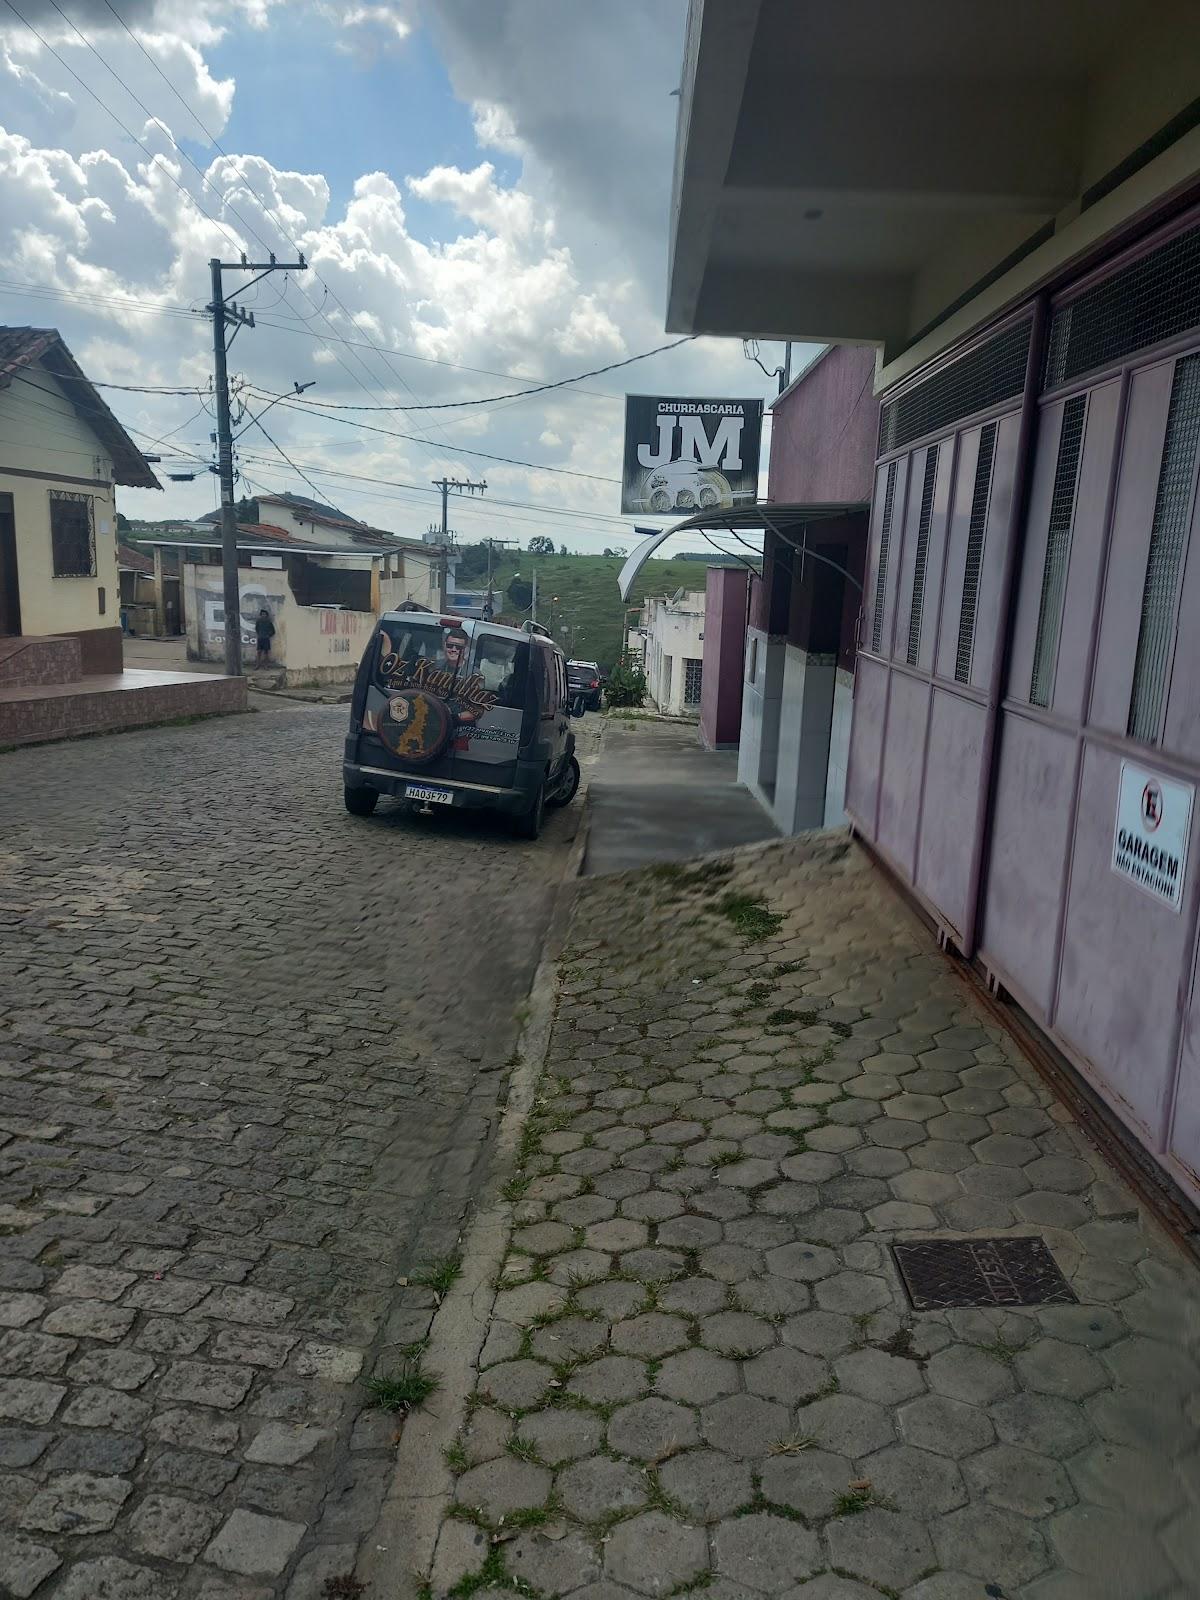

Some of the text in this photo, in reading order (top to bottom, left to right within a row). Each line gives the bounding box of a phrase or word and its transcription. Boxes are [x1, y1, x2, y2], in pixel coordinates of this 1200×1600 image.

[657, 402, 745, 415] CHURRASCARIA
[637, 414, 745, 471] JM
[380, 652, 409, 676] Oz
[1118, 827, 1179, 880] GARAGEM
